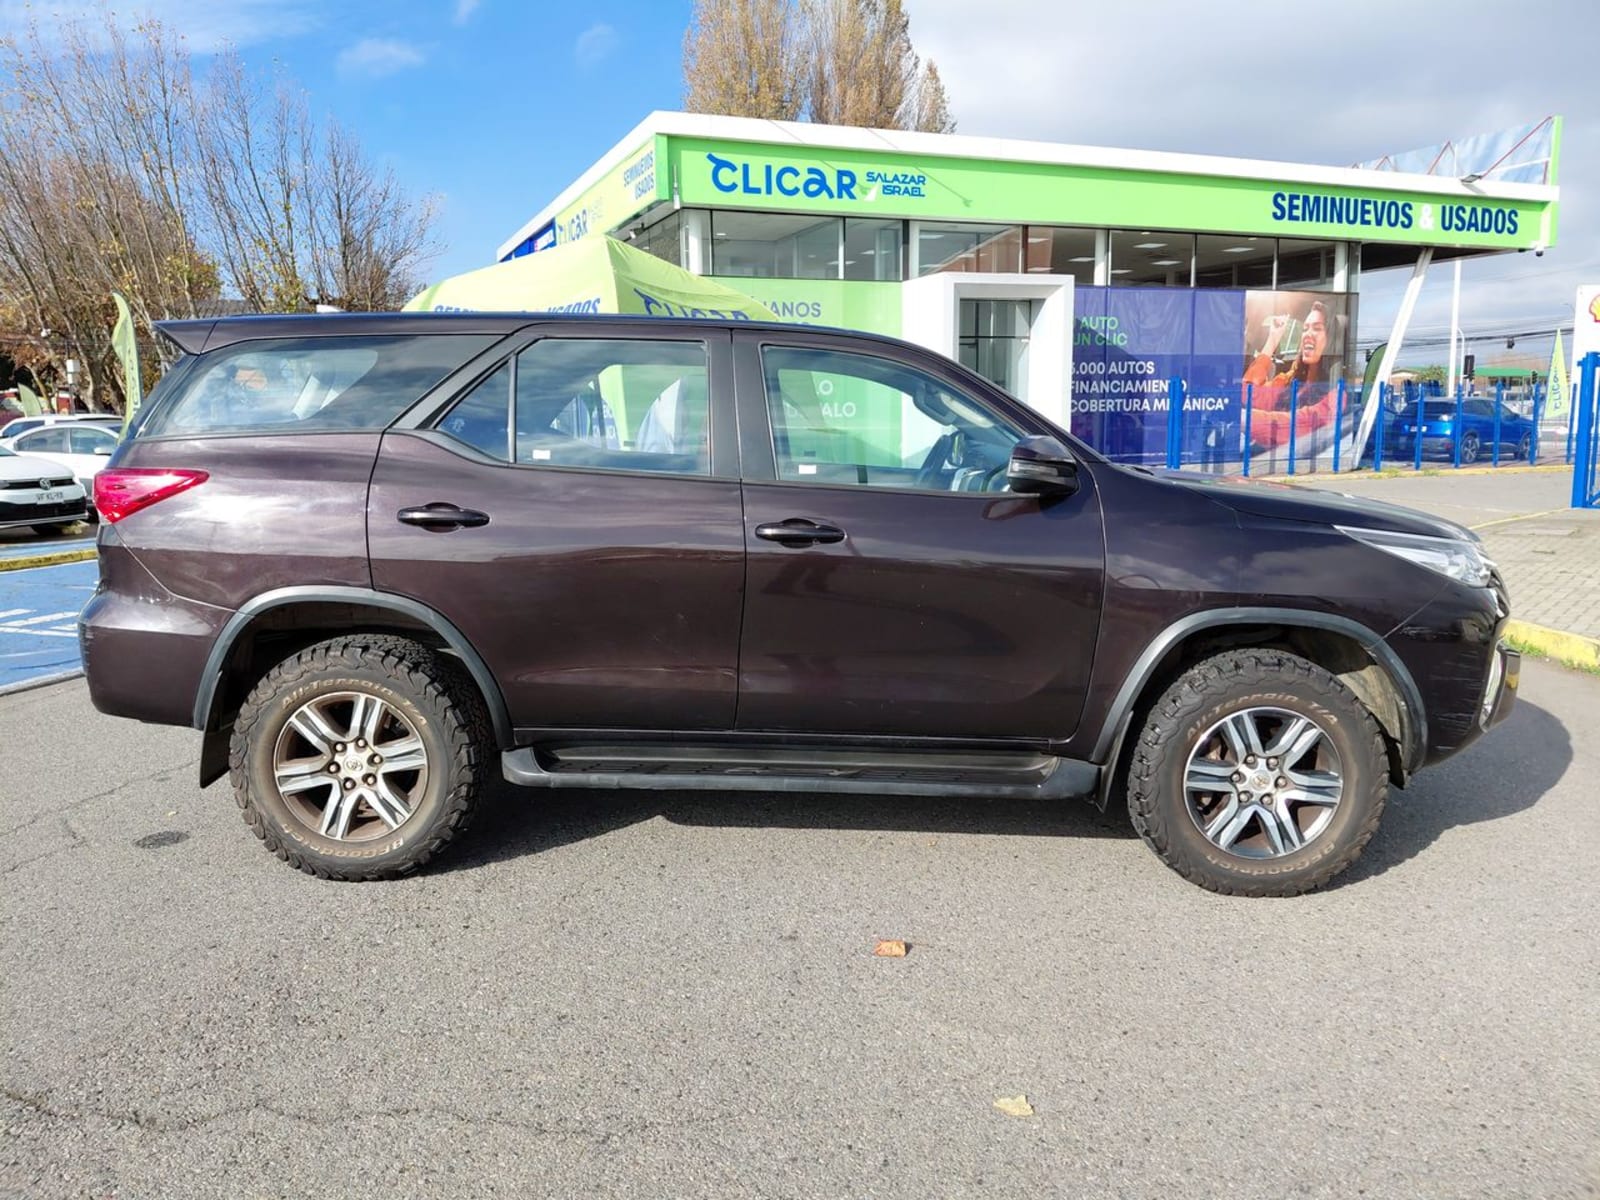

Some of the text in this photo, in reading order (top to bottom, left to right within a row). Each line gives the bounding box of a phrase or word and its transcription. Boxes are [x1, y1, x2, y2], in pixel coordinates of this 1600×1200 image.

[623, 151, 654, 188] SEMINUEVOS
[866, 171, 926, 185] SALAZAR
[634, 173, 655, 201] USADOS
[882, 185, 926, 198] ISRAEL
[1272, 192, 1519, 235] SEMINUEVOS & USADOS
[763, 301, 821, 318] ANOS
[1080, 316, 1119, 330] AUTO
[1094, 332, 1128, 346] CLIC
[1108, 360, 1155, 374] AUTOS
[1071, 398, 1151, 413] COBERTURA
